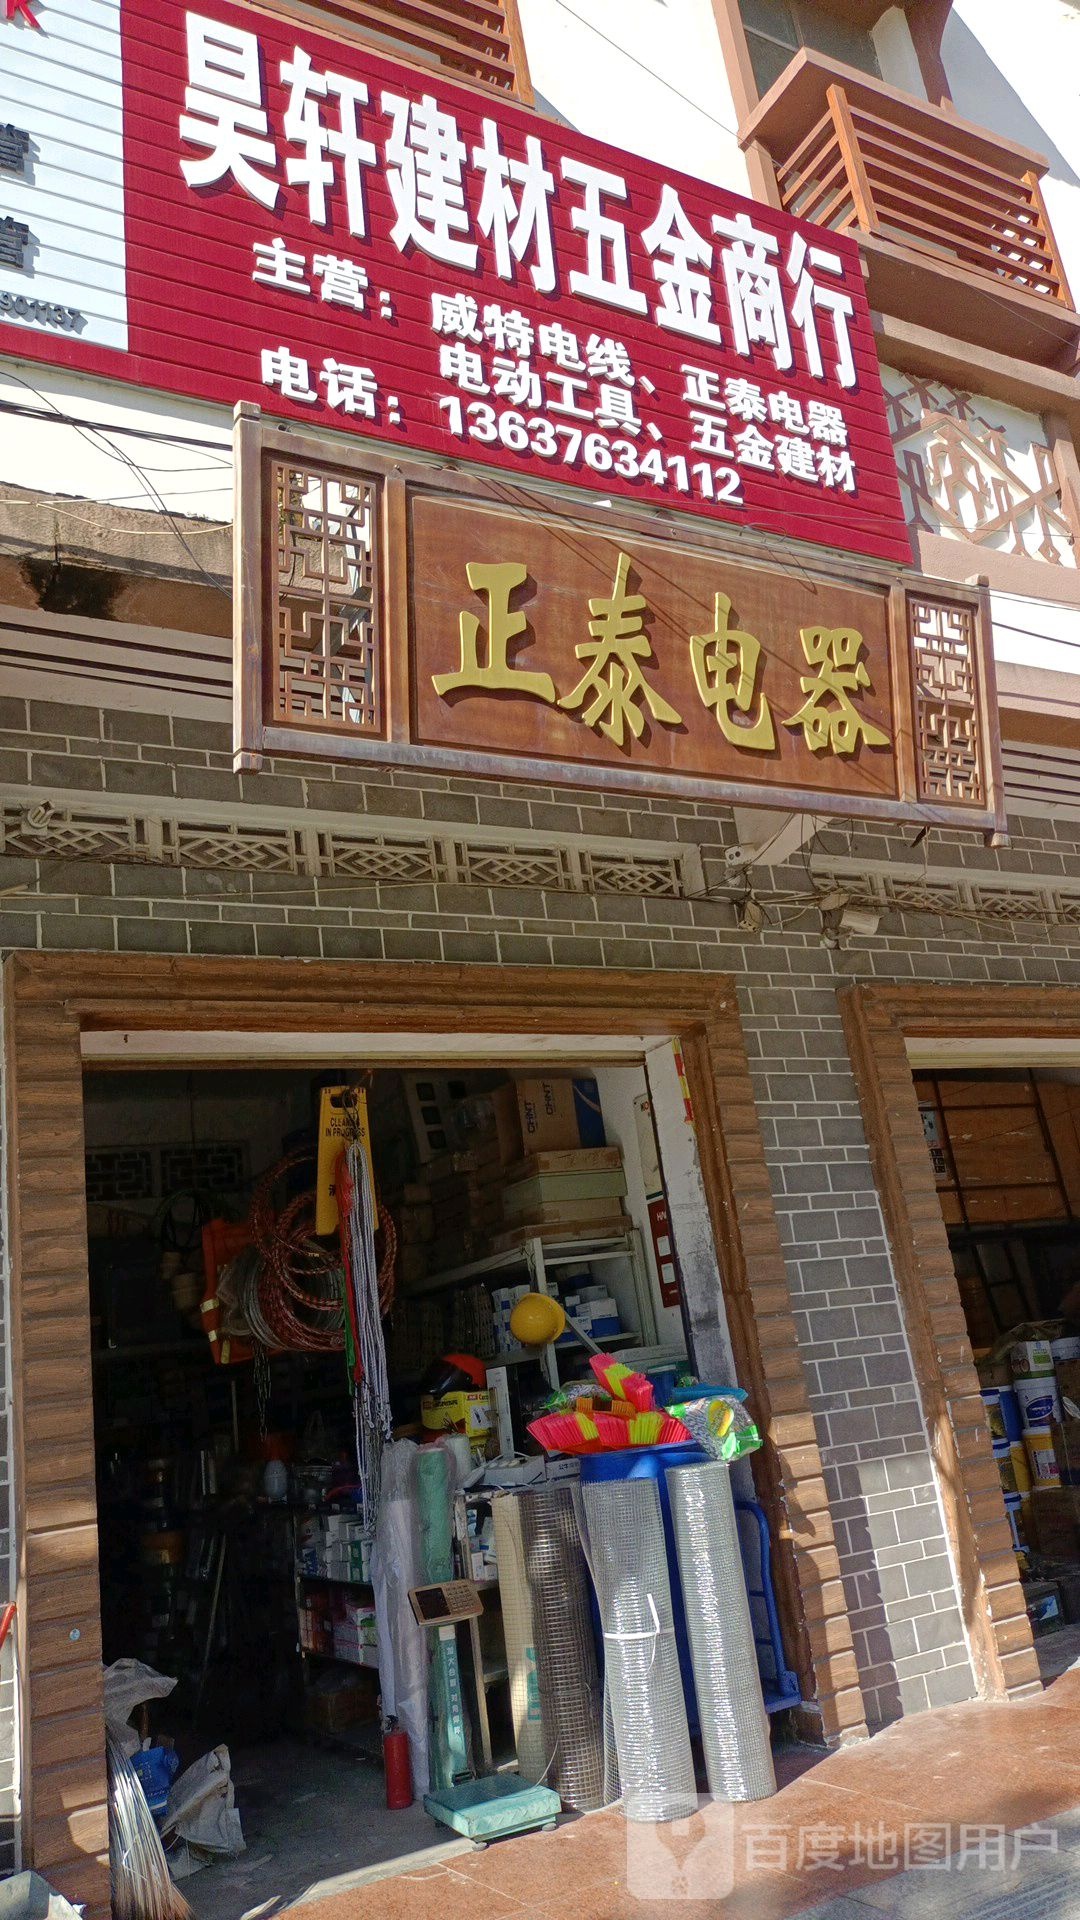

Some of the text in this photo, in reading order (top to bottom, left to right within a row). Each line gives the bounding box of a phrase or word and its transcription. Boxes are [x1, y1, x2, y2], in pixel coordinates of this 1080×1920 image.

[179, 11, 858, 389] 昊轩建材五金商行
[439, 395, 744, 506] 13637634112
[431, 552, 891, 754] 正泰电器
